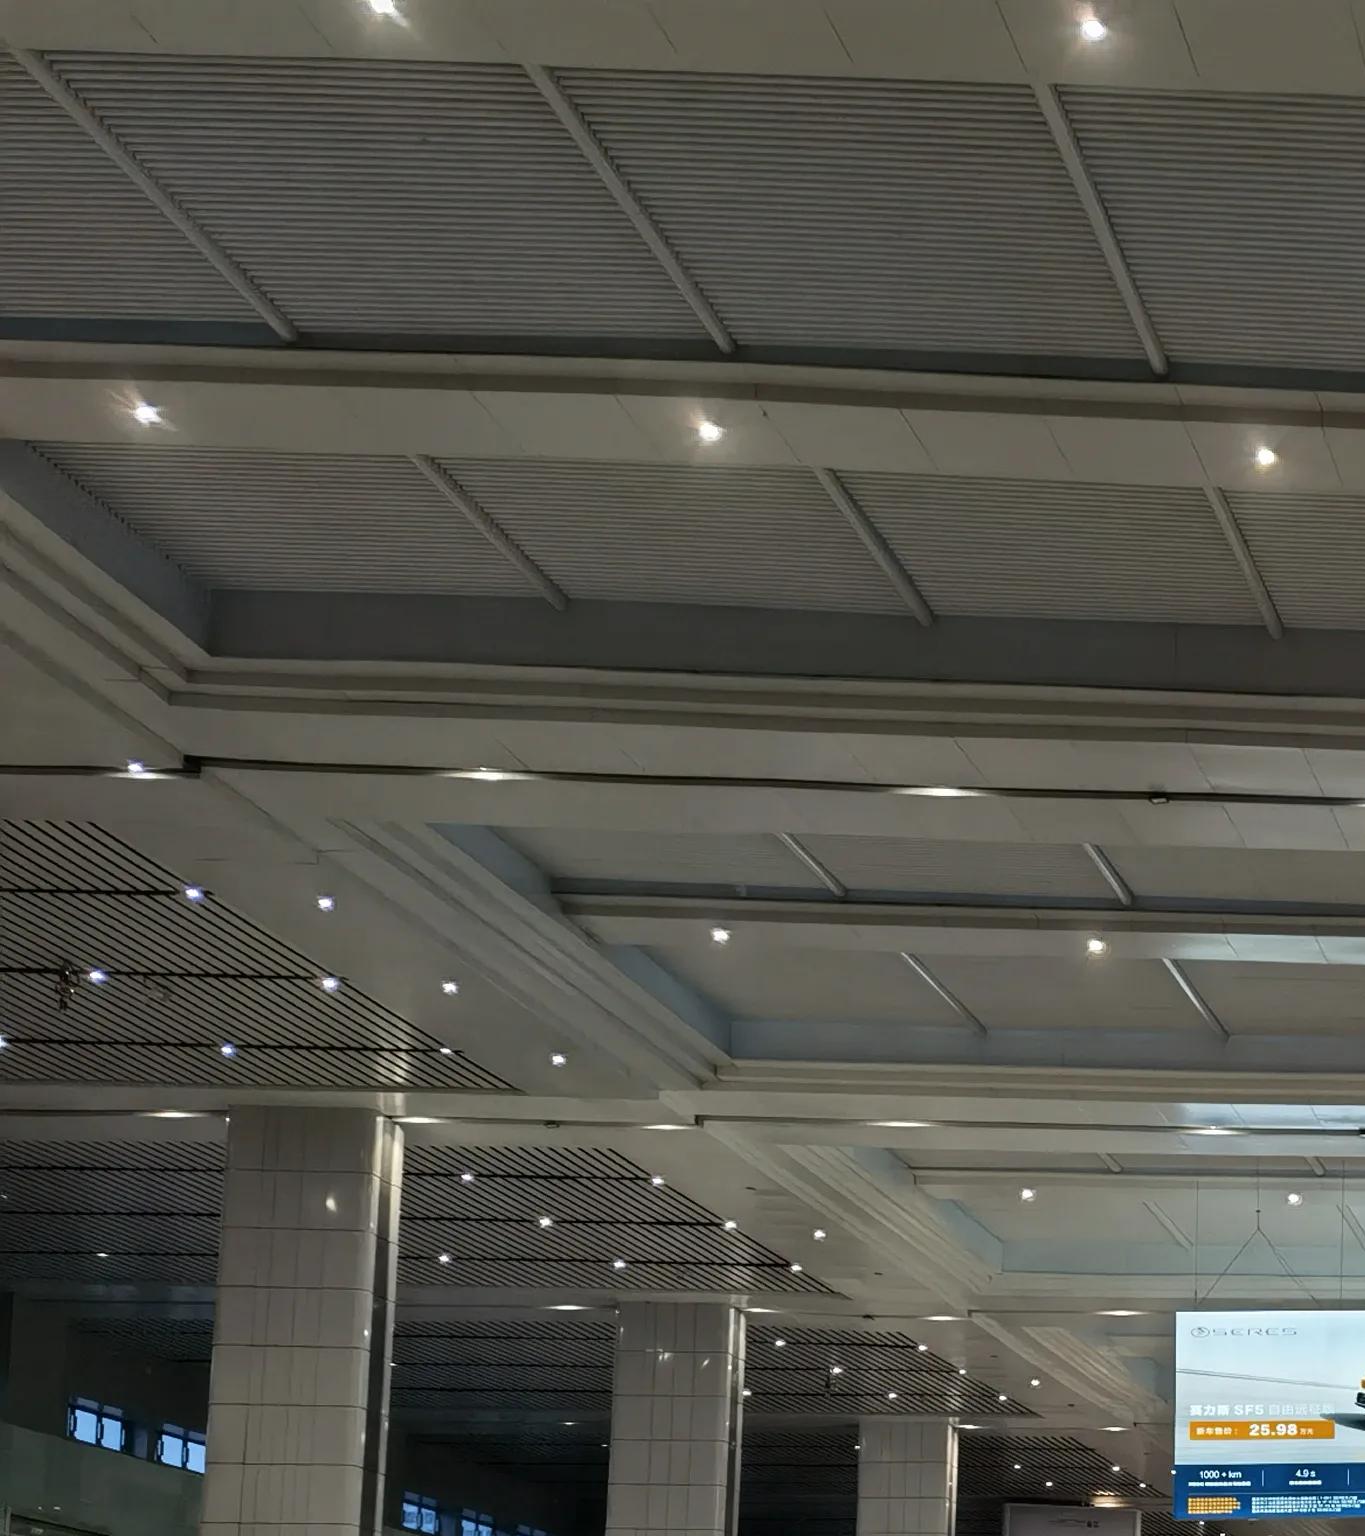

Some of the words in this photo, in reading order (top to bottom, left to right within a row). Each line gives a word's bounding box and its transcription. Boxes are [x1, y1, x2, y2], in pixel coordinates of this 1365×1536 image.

[1212, 1327, 1297, 1336] SERES
[1234, 1404, 1264, 1416] SF5
[1249, 1423, 1298, 1436] 25.98
[1296, 1469, 1309, 1477] 4.9
